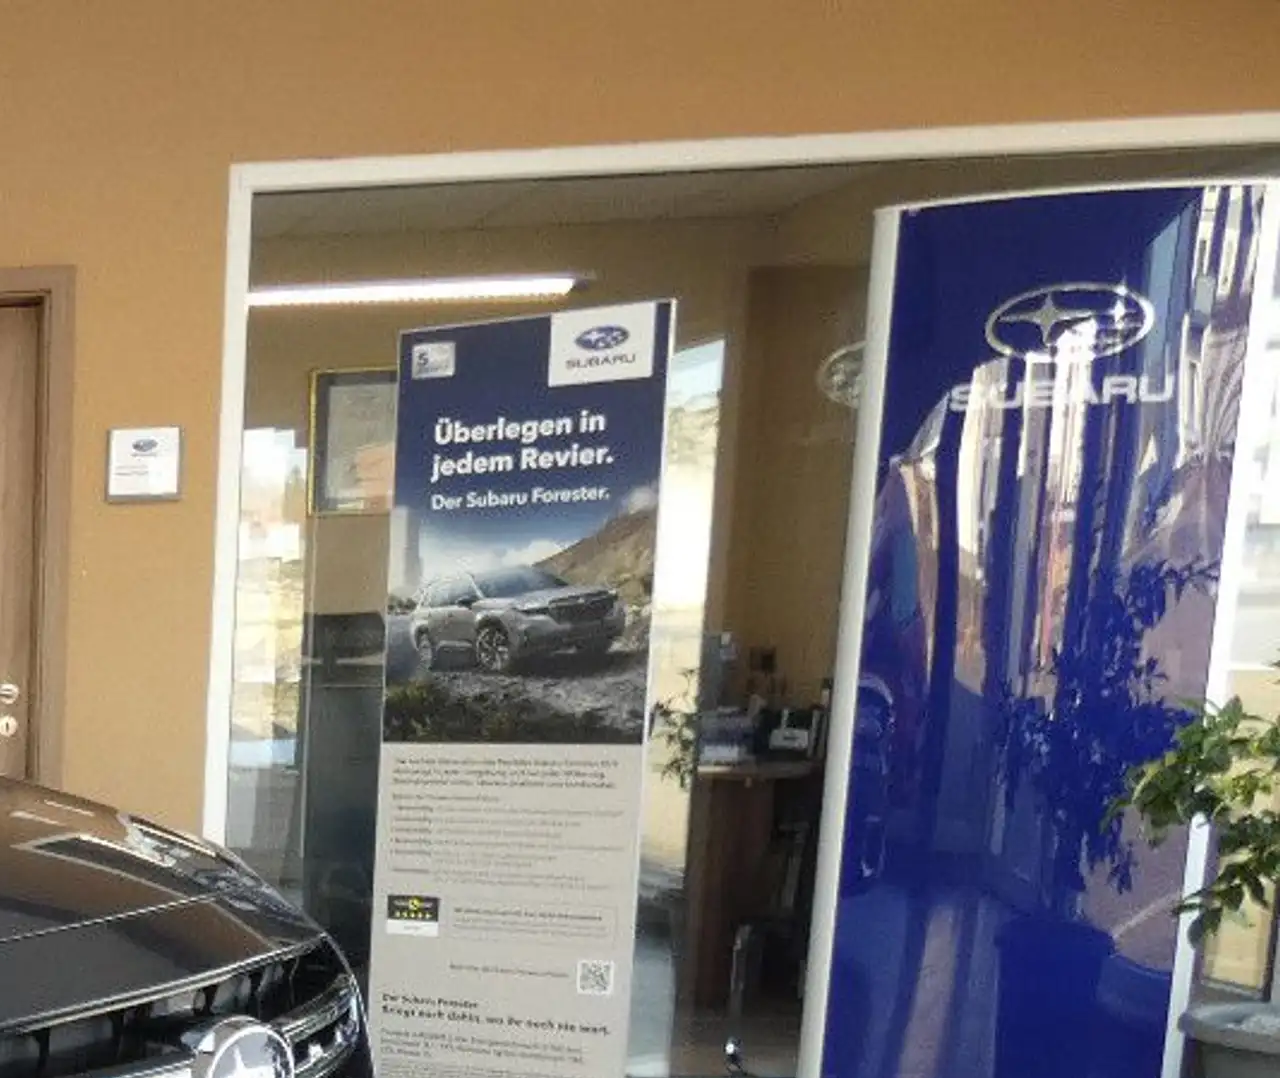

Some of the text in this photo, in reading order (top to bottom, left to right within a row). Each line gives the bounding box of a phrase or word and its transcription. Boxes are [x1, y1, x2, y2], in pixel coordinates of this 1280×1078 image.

[565, 353, 636, 369] SUBARU
[951, 374, 1174, 412] SUBARU
[434, 410, 605, 446] Überlegen in
[431, 446, 614, 483] jedem Revier.
[432, 485, 610, 510] Der Subaru Forester.
